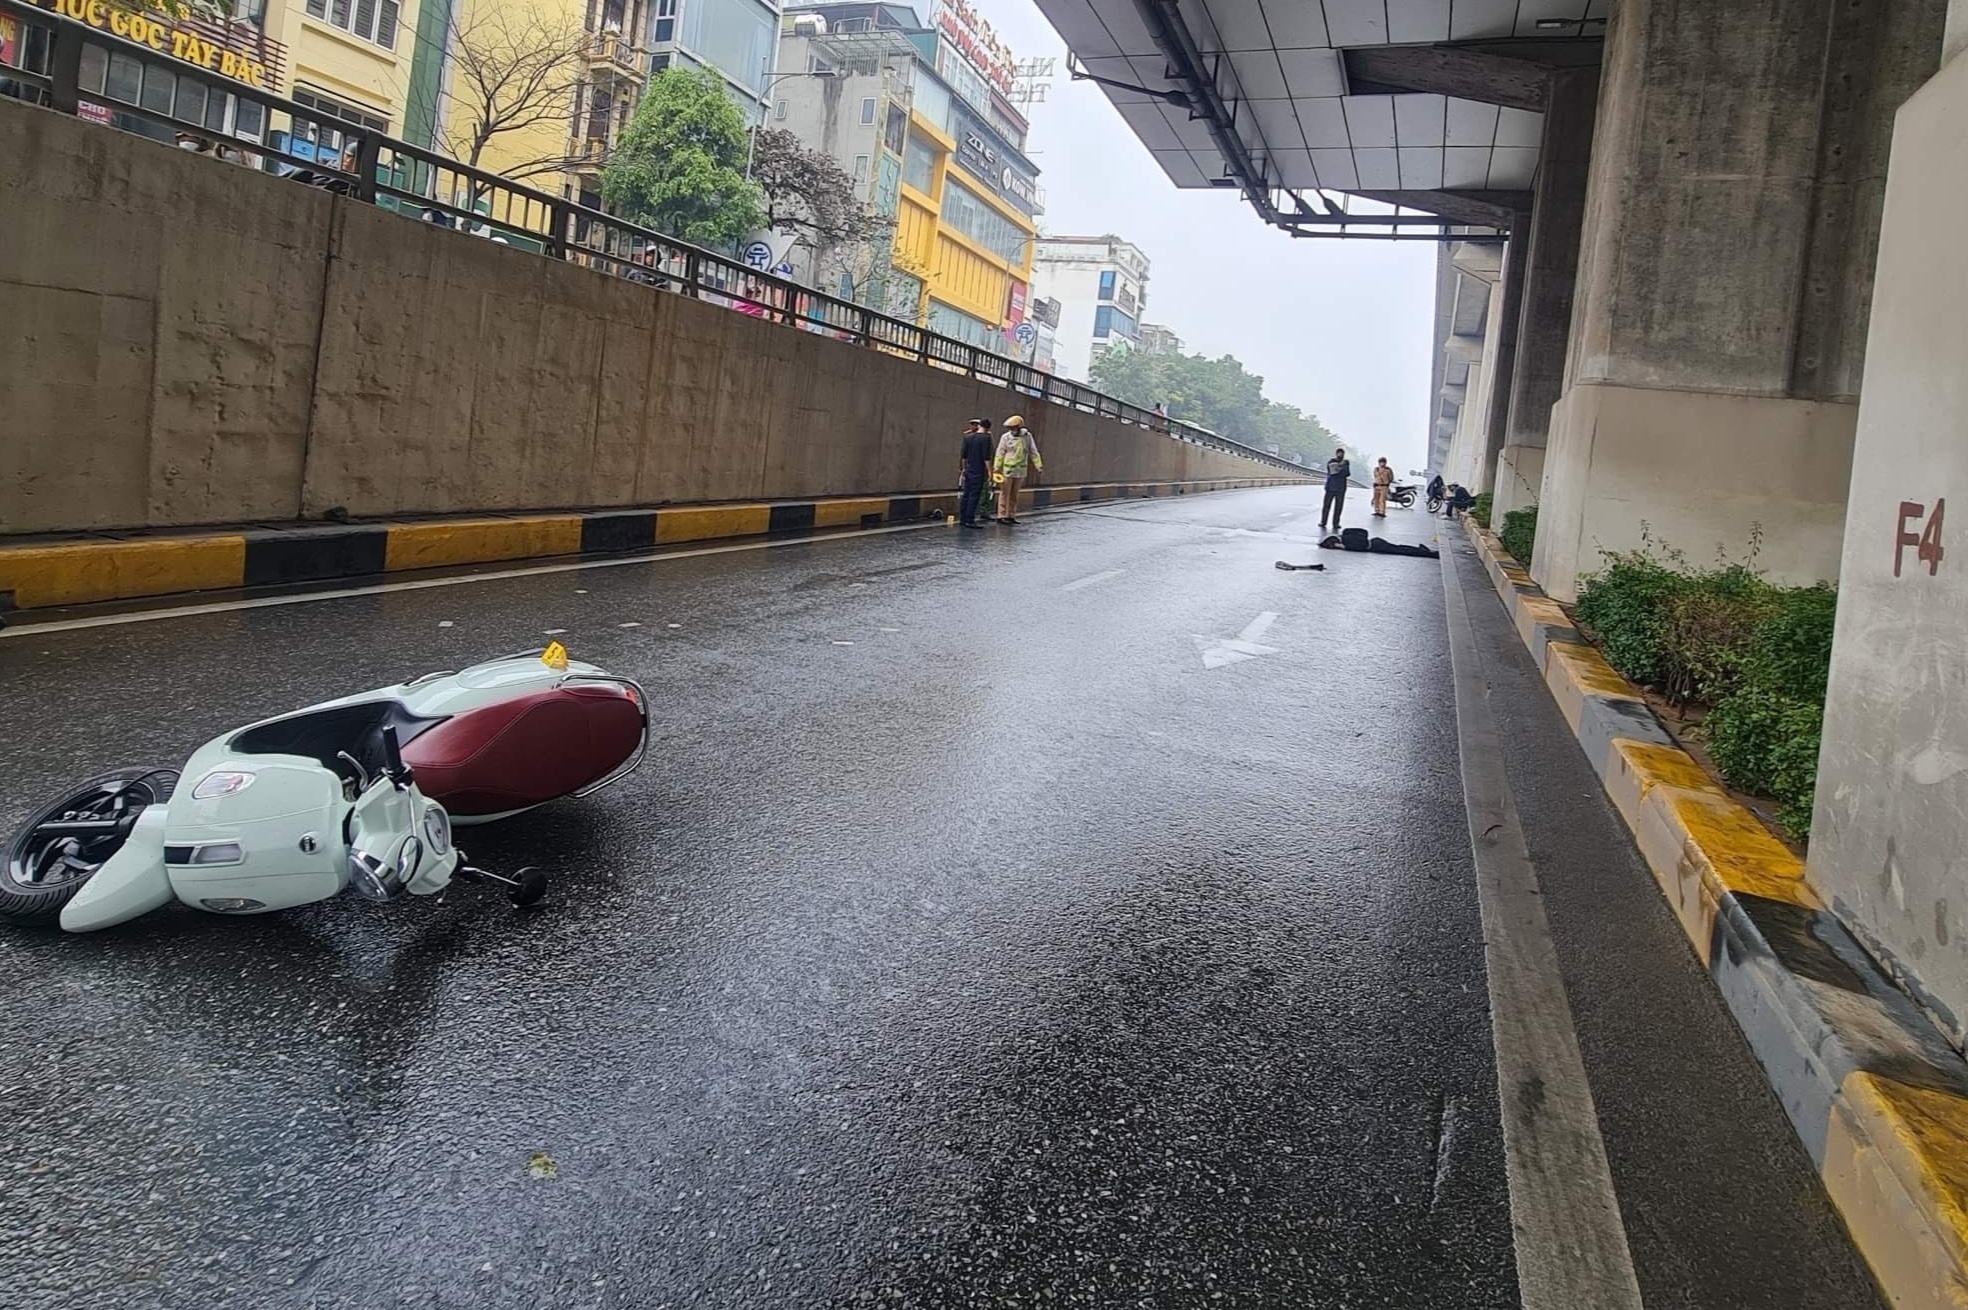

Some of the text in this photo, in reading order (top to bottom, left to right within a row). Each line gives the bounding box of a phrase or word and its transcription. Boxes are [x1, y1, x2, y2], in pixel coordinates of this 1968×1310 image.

[171, 30, 218, 69] TÂY
[965, 131, 996, 165] ZONE
[1893, 497, 1945, 579] F4
